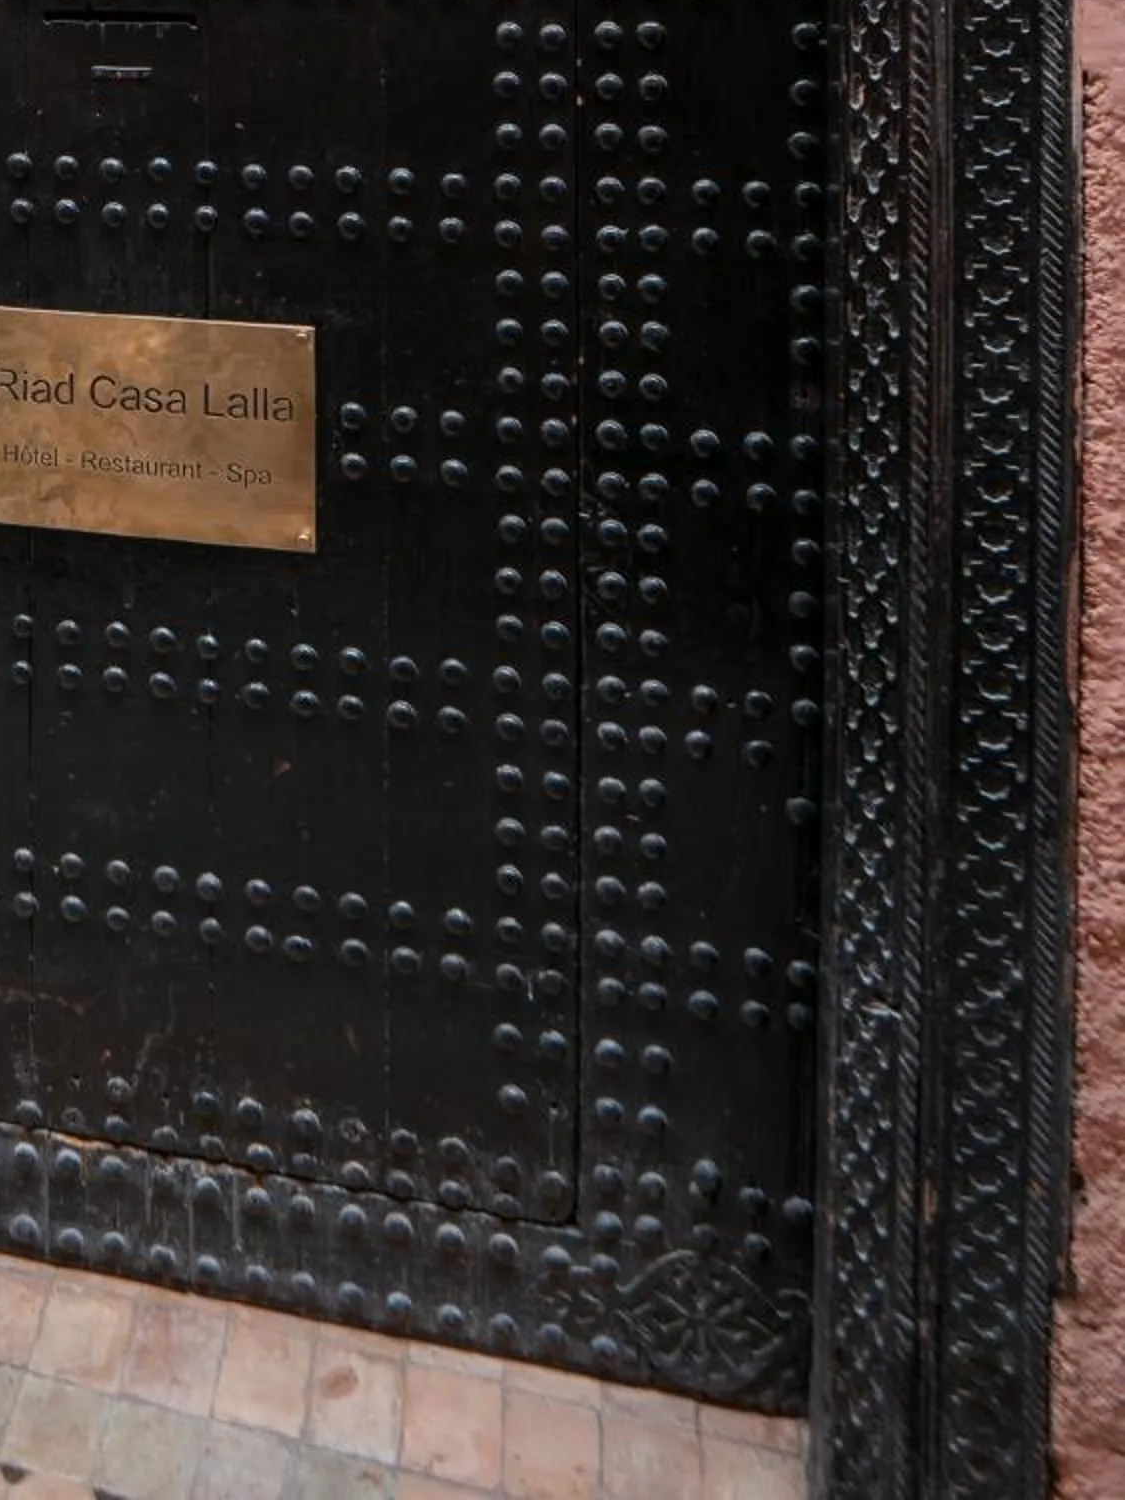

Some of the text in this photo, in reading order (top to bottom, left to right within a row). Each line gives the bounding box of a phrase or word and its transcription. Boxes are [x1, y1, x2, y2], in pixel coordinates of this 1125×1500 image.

[90, 375, 186, 414] Casa
[203, 384, 294, 422] Lalla
[81, 452, 201, 479] Restaurant
[227, 463, 272, 489] Spa
